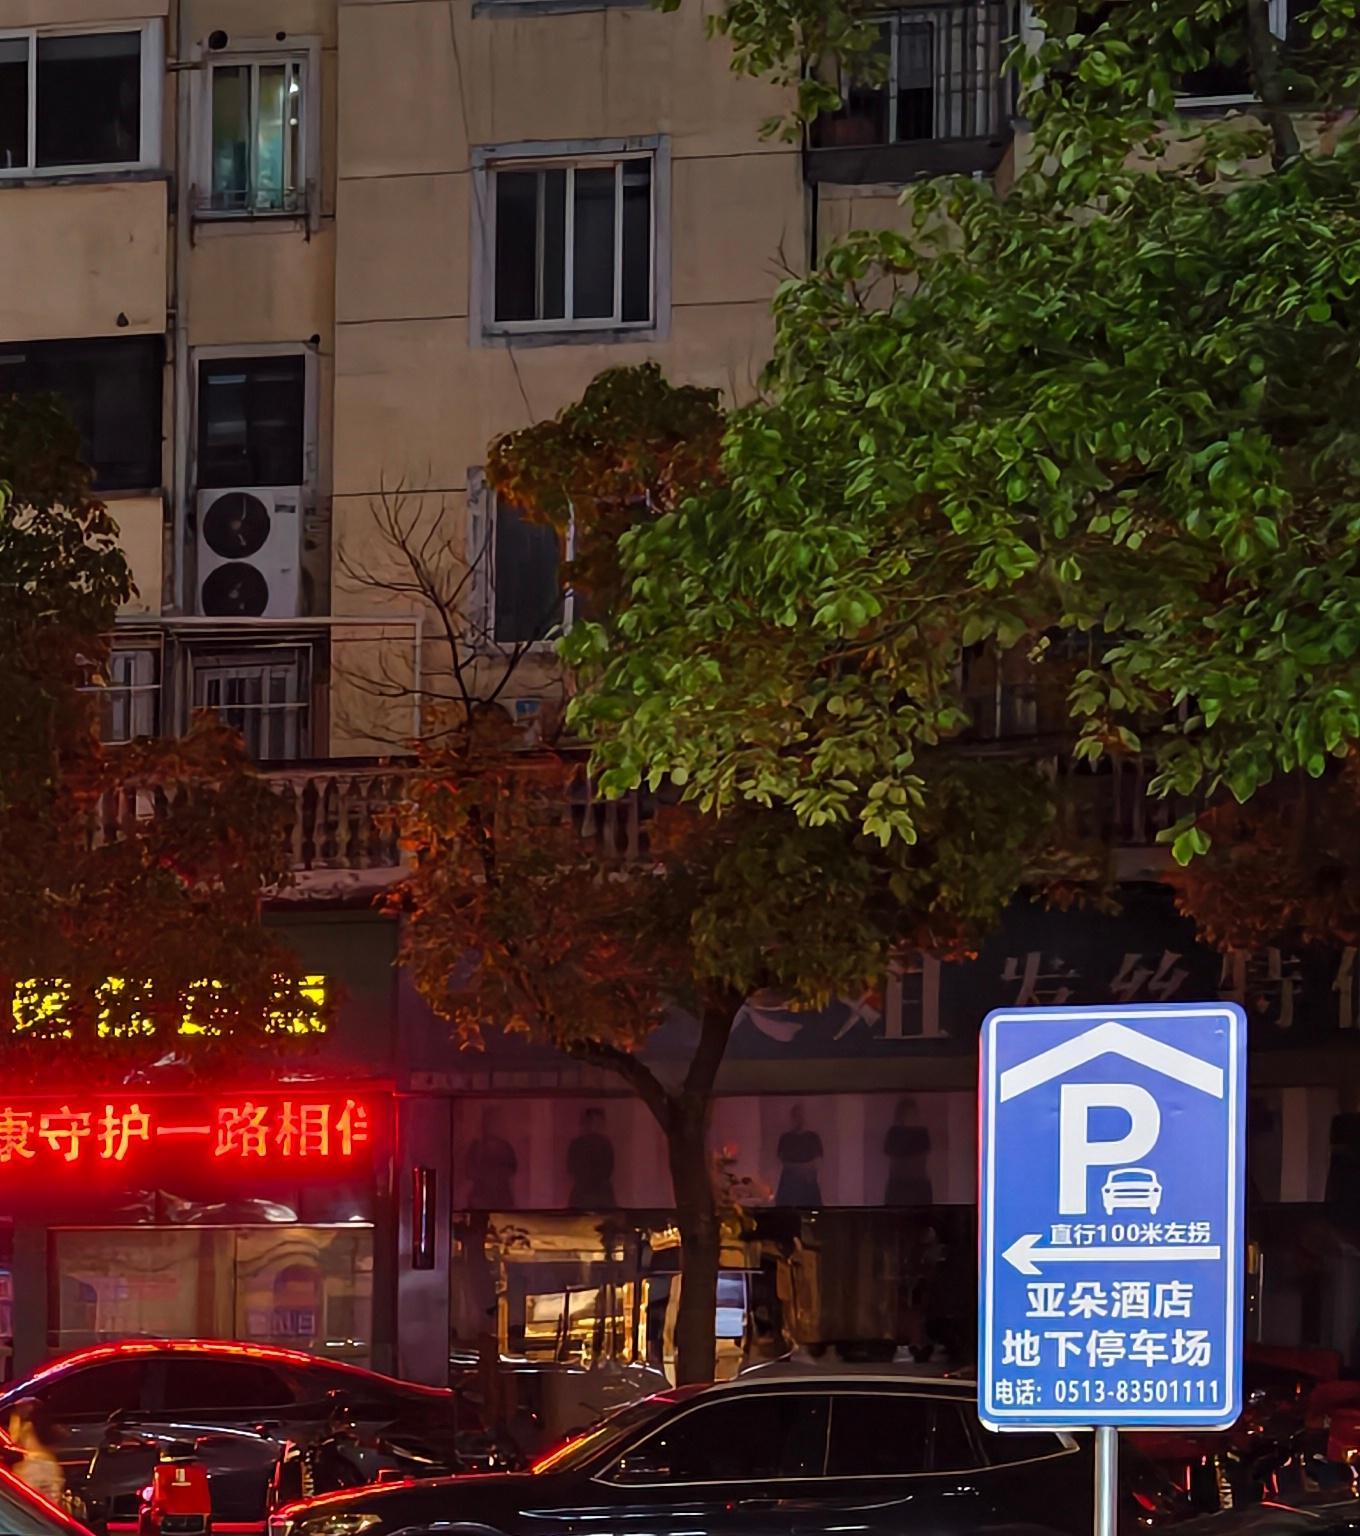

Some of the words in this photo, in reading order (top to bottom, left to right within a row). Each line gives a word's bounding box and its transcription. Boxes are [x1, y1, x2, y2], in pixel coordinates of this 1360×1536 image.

[1058, 1083, 1161, 1215] P
[1050, 1221, 1211, 1245] 直行100米左拐
[1025, 1280, 1194, 1319] 亚朵酒店
[1001, 1328, 1212, 1368] 地下停车场
[1055, 1380, 1218, 1403] 0513-83501111
